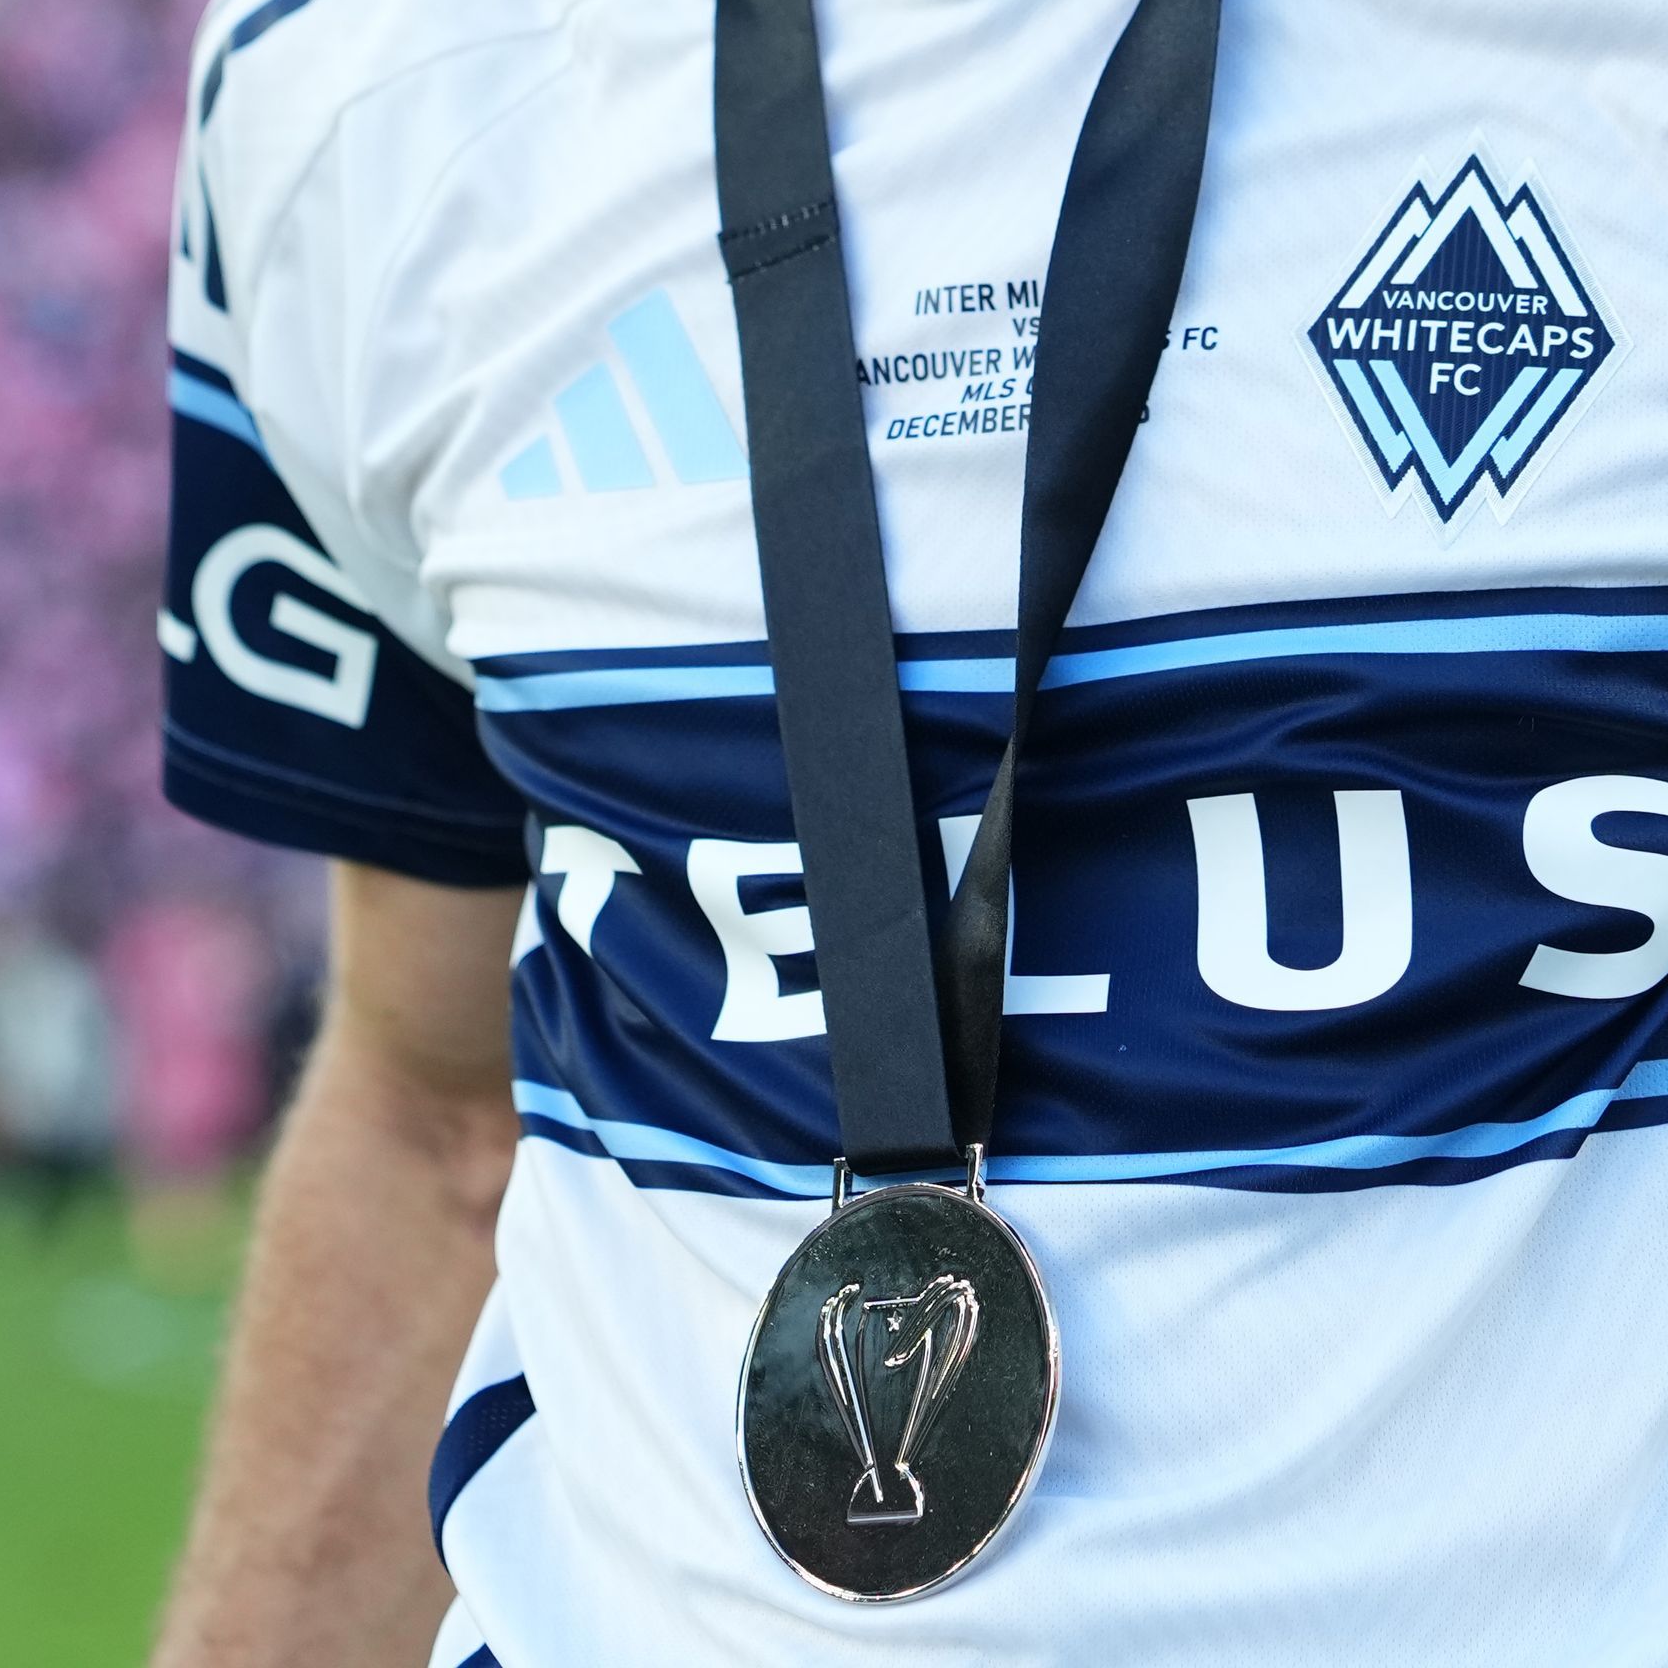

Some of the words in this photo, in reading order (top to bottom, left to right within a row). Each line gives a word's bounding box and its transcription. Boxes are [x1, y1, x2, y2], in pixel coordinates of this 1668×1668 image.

[915, 281, 996, 316] INTER
[1381, 289, 1549, 315] VANCOUVER
[1012, 316, 1041, 337] VS
[1326, 317, 1595, 360] WHITECAPS
[856, 349, 1001, 386] ANCOUVER
[1182, 326, 1219, 351] FC
[960, 377, 1017, 404] MLS
[1429, 362, 1482, 396] FC
[886, 403, 1031, 440] DECEMBER
